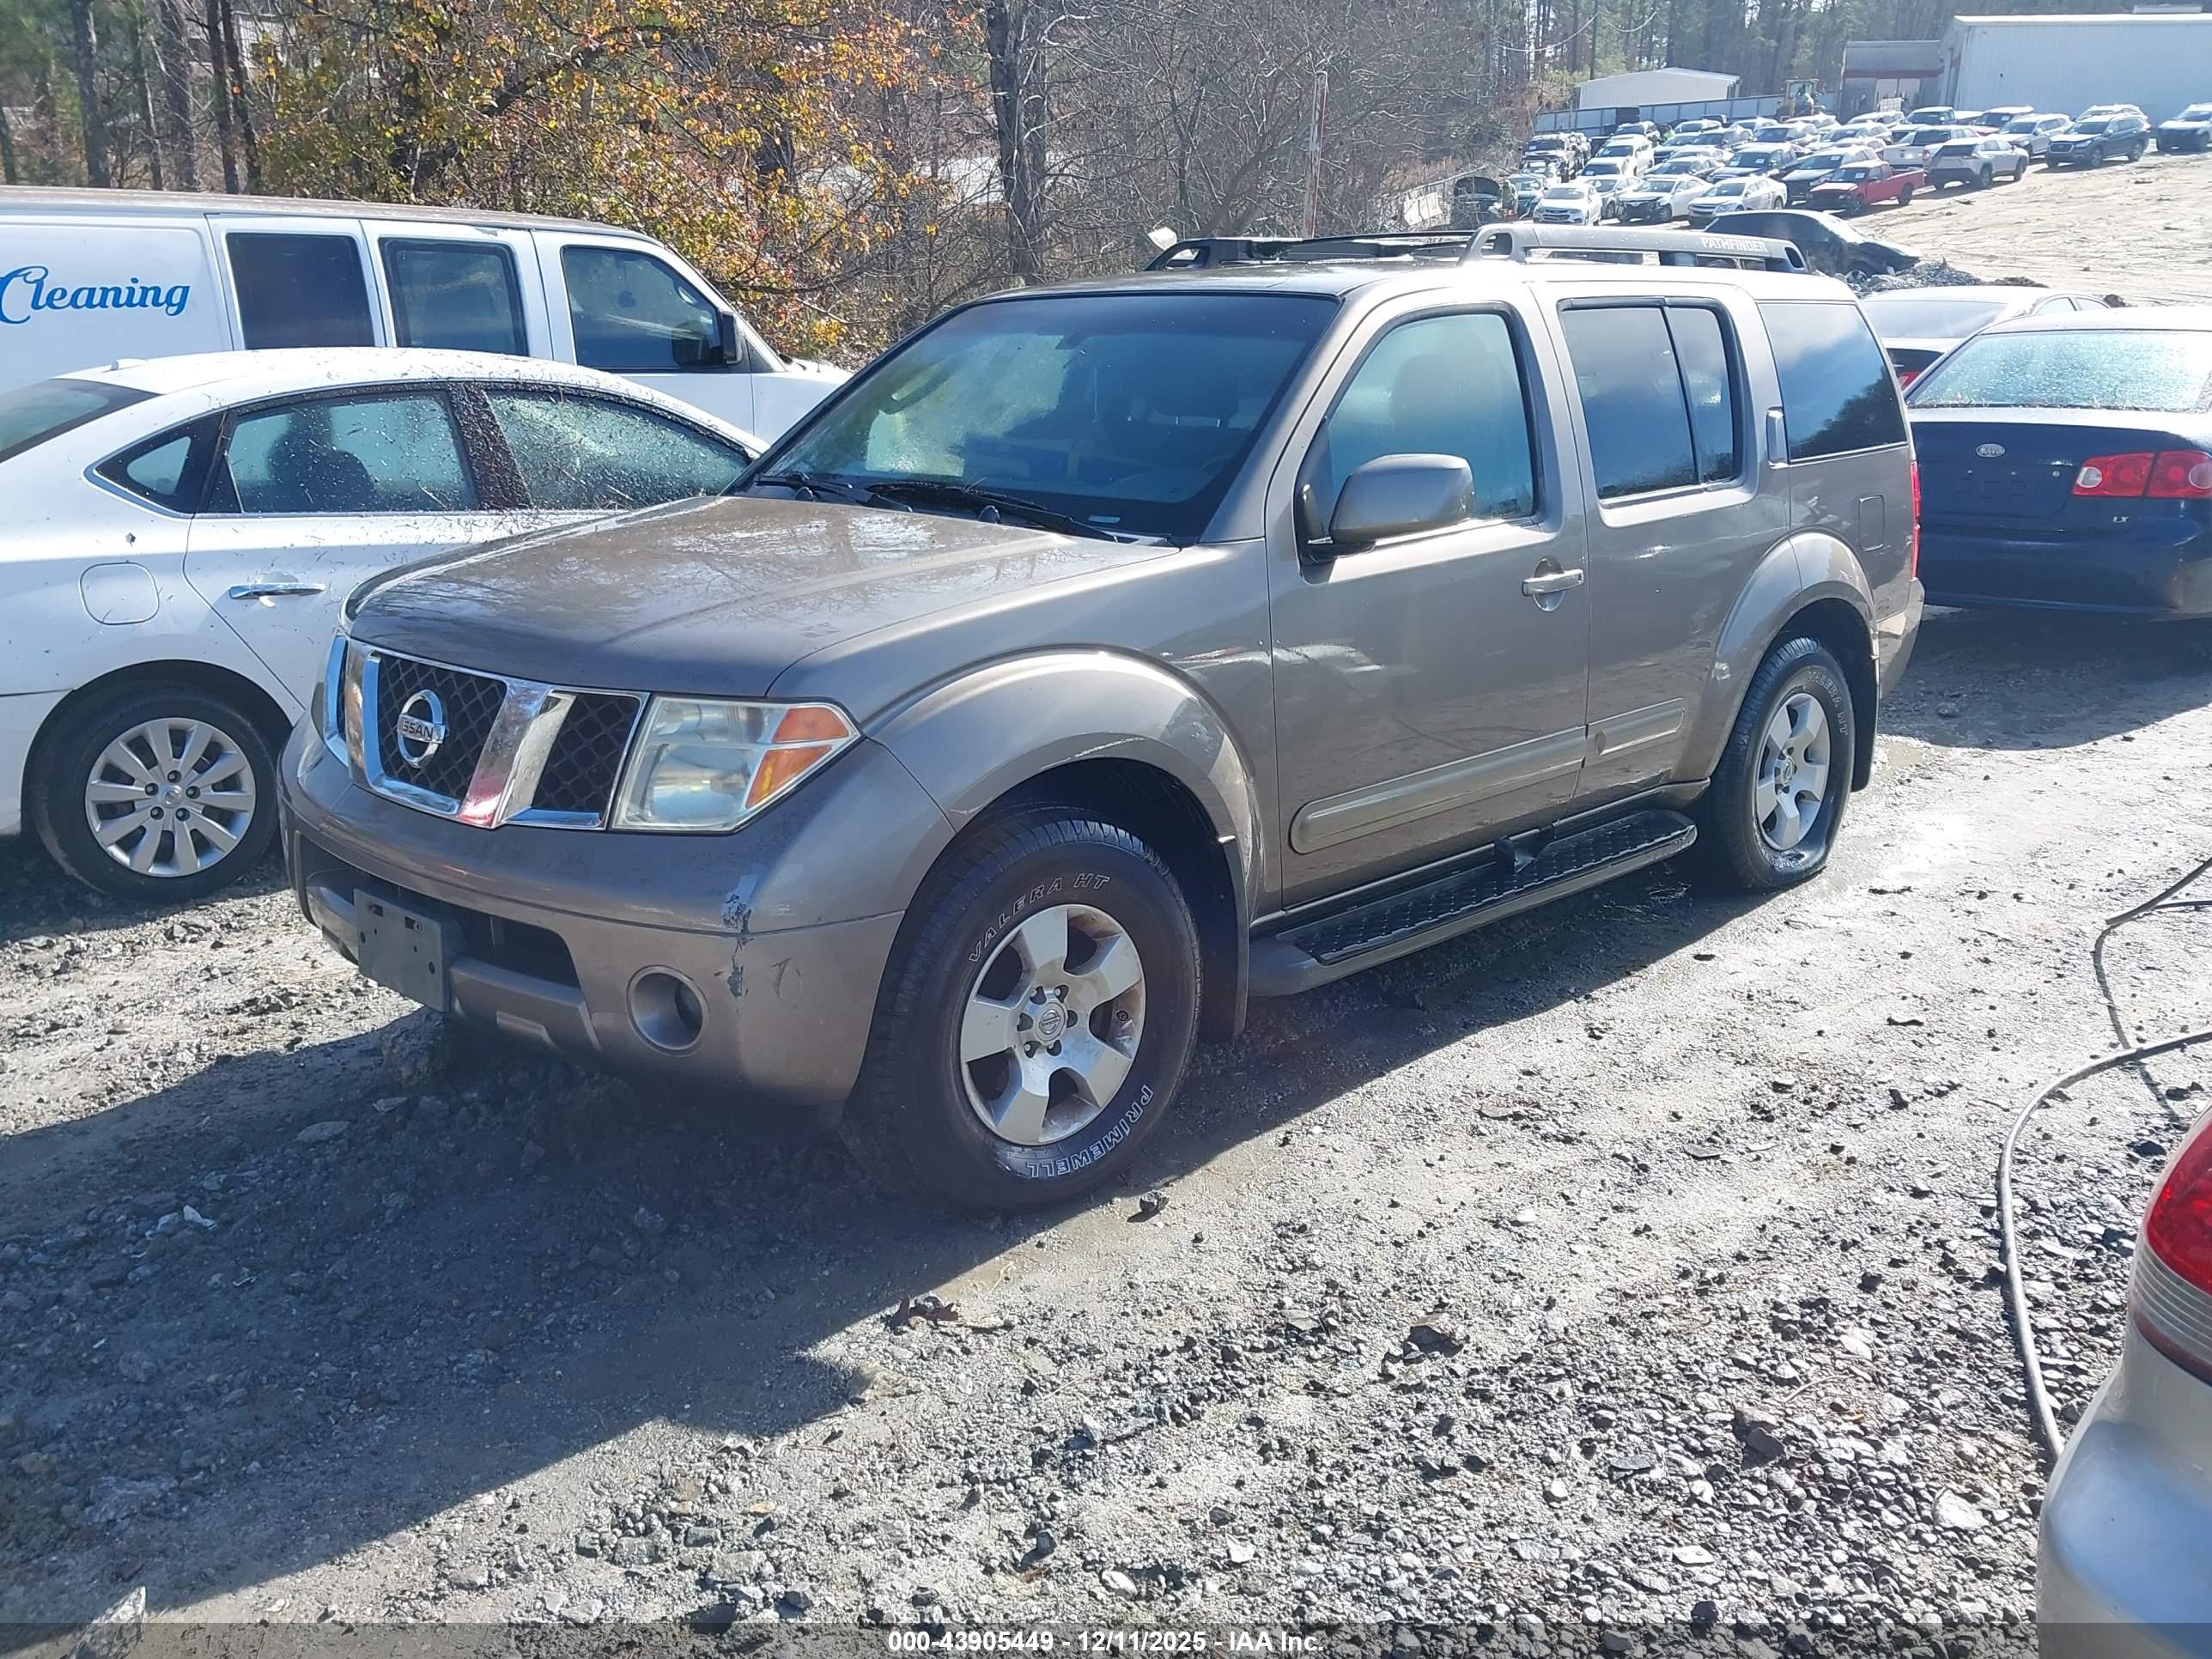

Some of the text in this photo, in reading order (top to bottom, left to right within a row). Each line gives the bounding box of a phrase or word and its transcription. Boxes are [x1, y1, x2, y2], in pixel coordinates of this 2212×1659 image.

[1700, 236, 1767, 252] PATHFINDER
[0, 265, 191, 324] Cleaning
[398, 717, 434, 740] SSAN
[969, 873, 1110, 962] VALERA HT
[1026, 1085, 1154, 1178] PRIMEWELL
